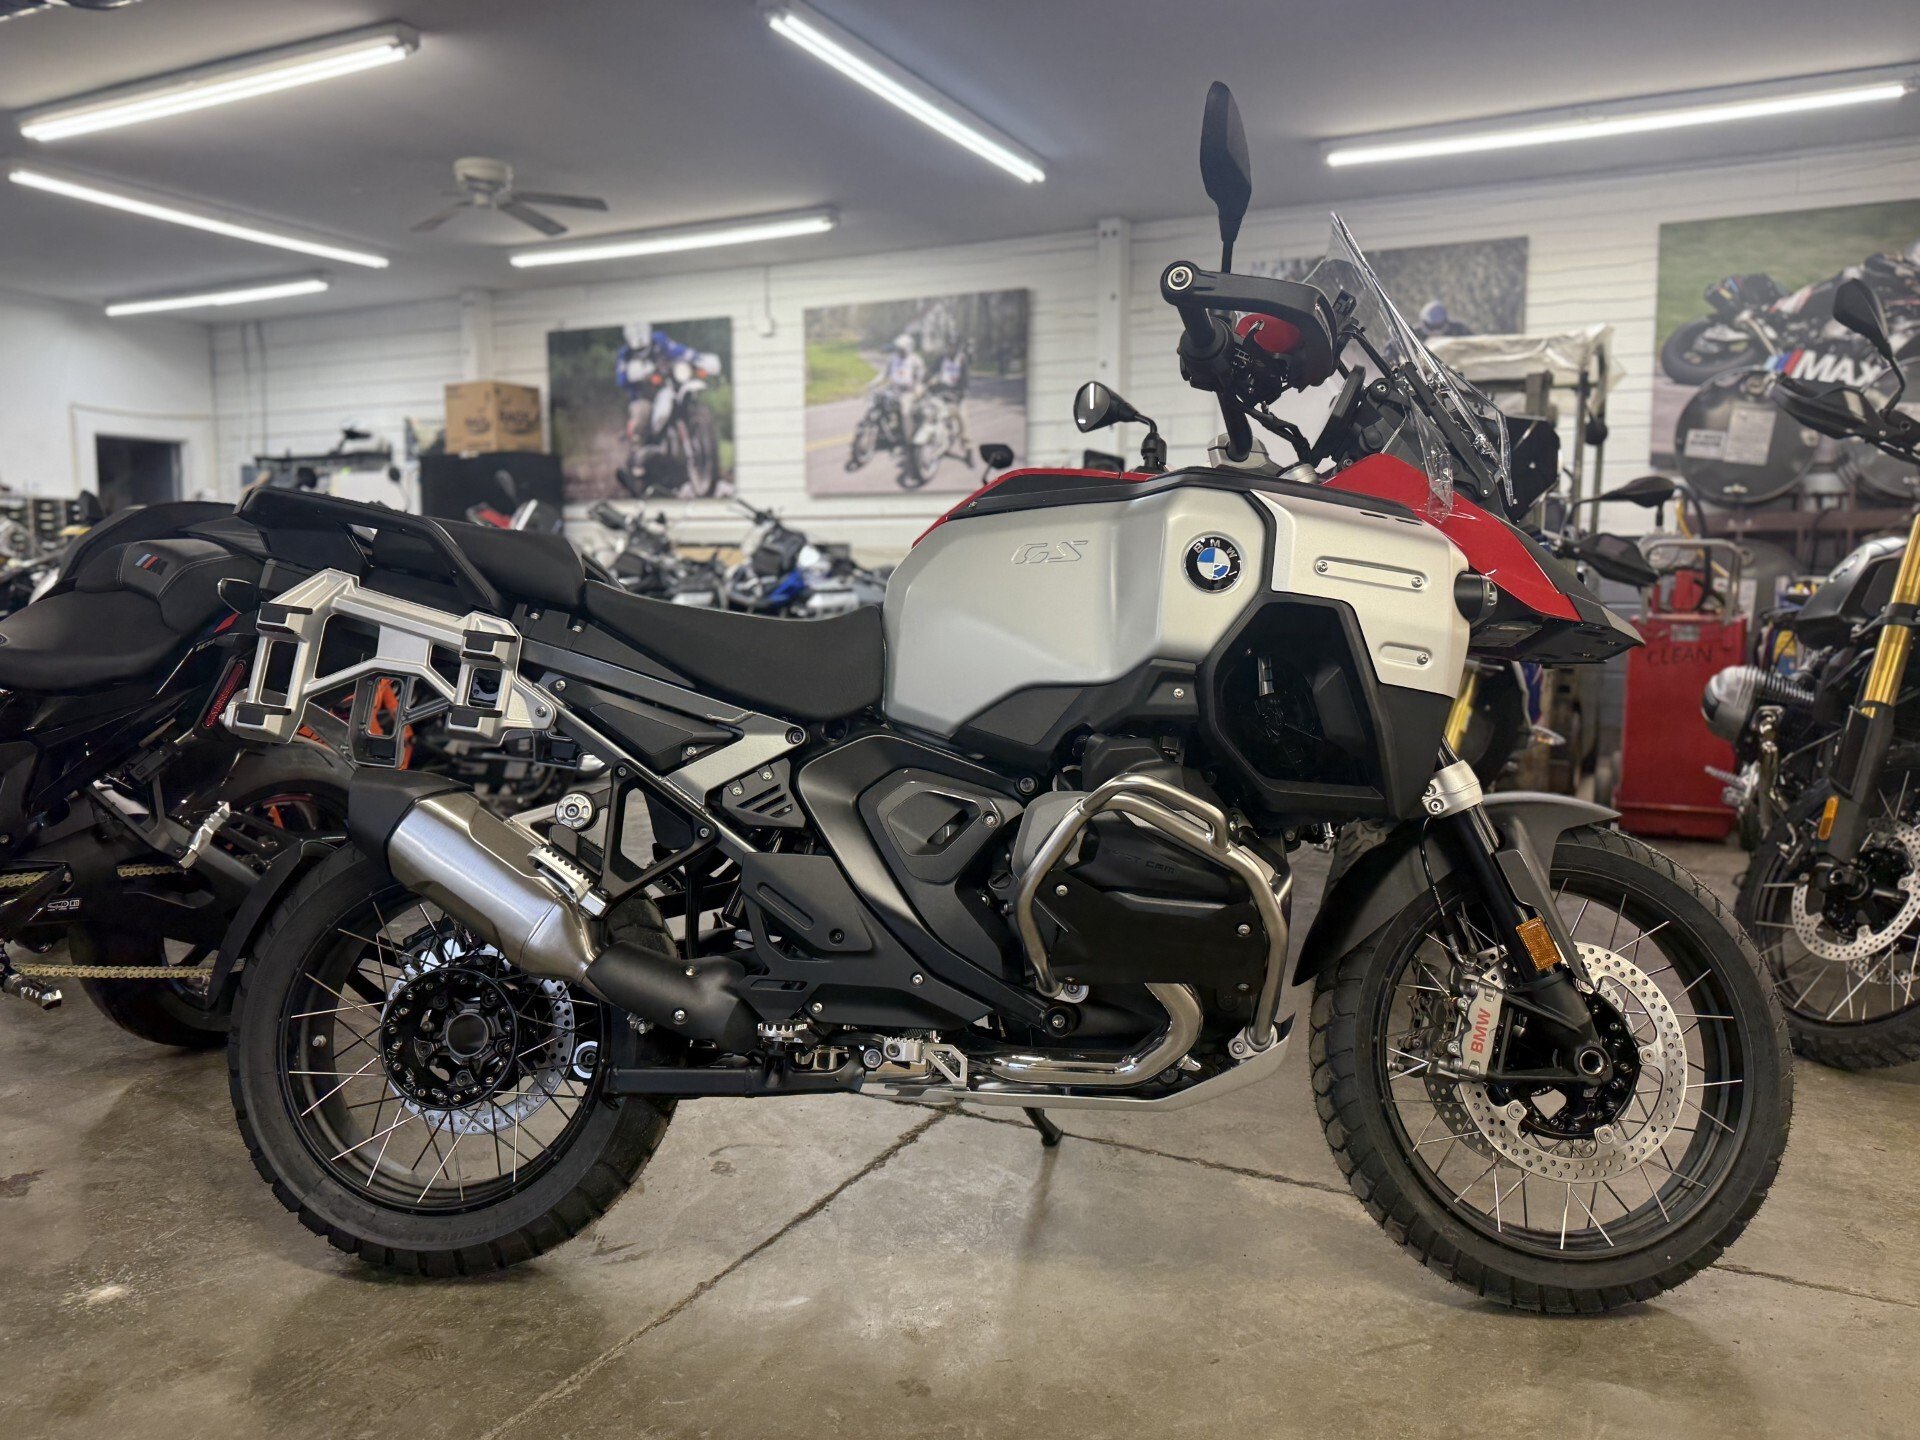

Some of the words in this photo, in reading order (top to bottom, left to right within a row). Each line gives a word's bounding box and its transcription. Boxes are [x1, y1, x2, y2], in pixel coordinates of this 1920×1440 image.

[1011, 540, 1088, 564] GS
[1193, 539, 1238, 559] BMW
[1646, 647, 1712, 666] CLEAN
[1470, 1007, 1491, 1054] BMW
